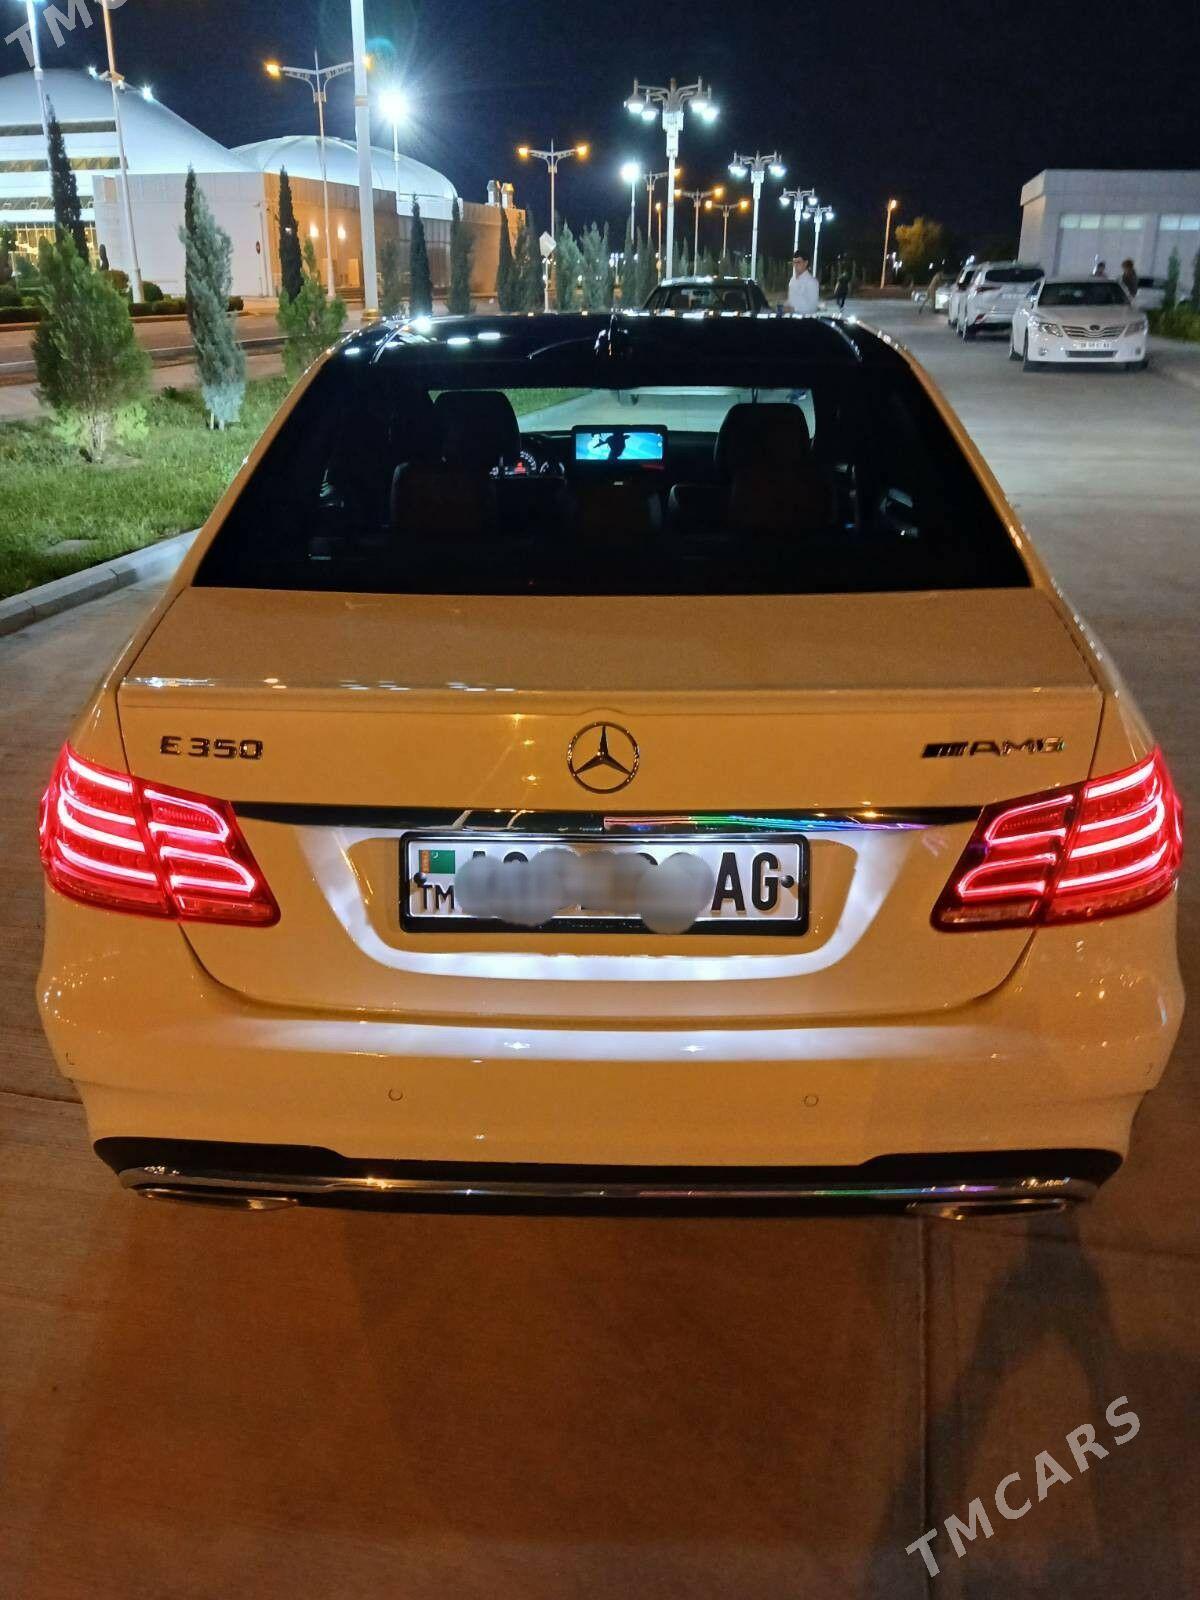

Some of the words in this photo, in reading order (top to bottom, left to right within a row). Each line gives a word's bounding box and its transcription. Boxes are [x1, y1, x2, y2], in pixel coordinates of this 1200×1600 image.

[160, 735, 182, 755] E
[188, 737, 264, 760] 350
[969, 737, 1065, 757] AMG
[710, 851, 780, 911] AG
[419, 884, 455, 910] TM
